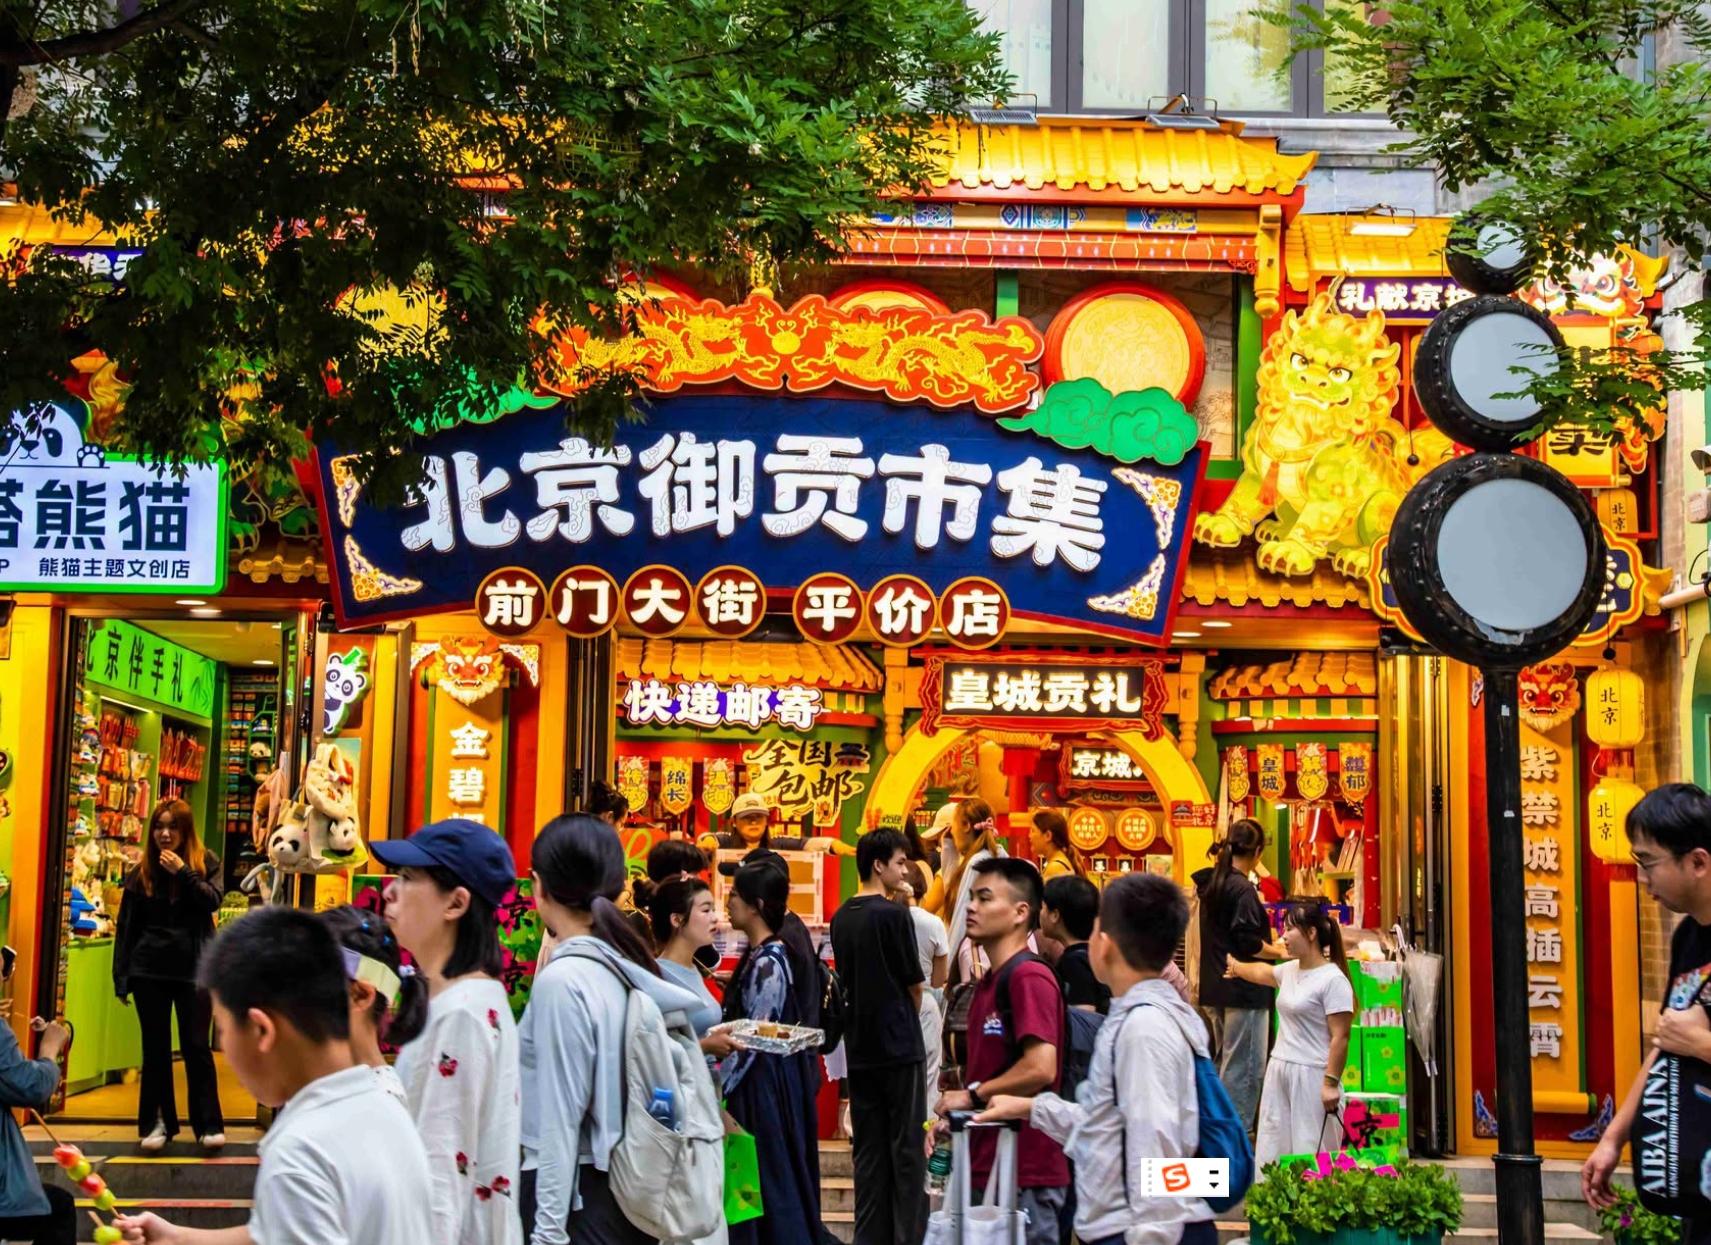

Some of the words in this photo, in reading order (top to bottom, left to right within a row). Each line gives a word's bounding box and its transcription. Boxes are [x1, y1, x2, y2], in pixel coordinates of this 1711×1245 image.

[400, 432, 1109, 574] 北京御贡市集
[1612, 502, 1626, 531] 北京
[38, 557, 190, 579] 熊猫主题文创店
[483, 577, 759, 636] 前门大街
[803, 582, 1003, 638] 平价店
[625, 680, 822, 729] 快递邮寄
[947, 670, 1141, 715] 皇城贡礼
[1600, 686, 1618, 725] 北京
[448, 721, 488, 824] 金碧
[746, 739, 832, 771] 全国
[1072, 750, 1143, 778] 京城
[667, 770, 687, 802] 绵长
[753, 769, 853, 816] 包邮
[1597, 802, 1613, 841] 北京
[1521, 745, 1563, 1058] 紫禁城高插云霄
